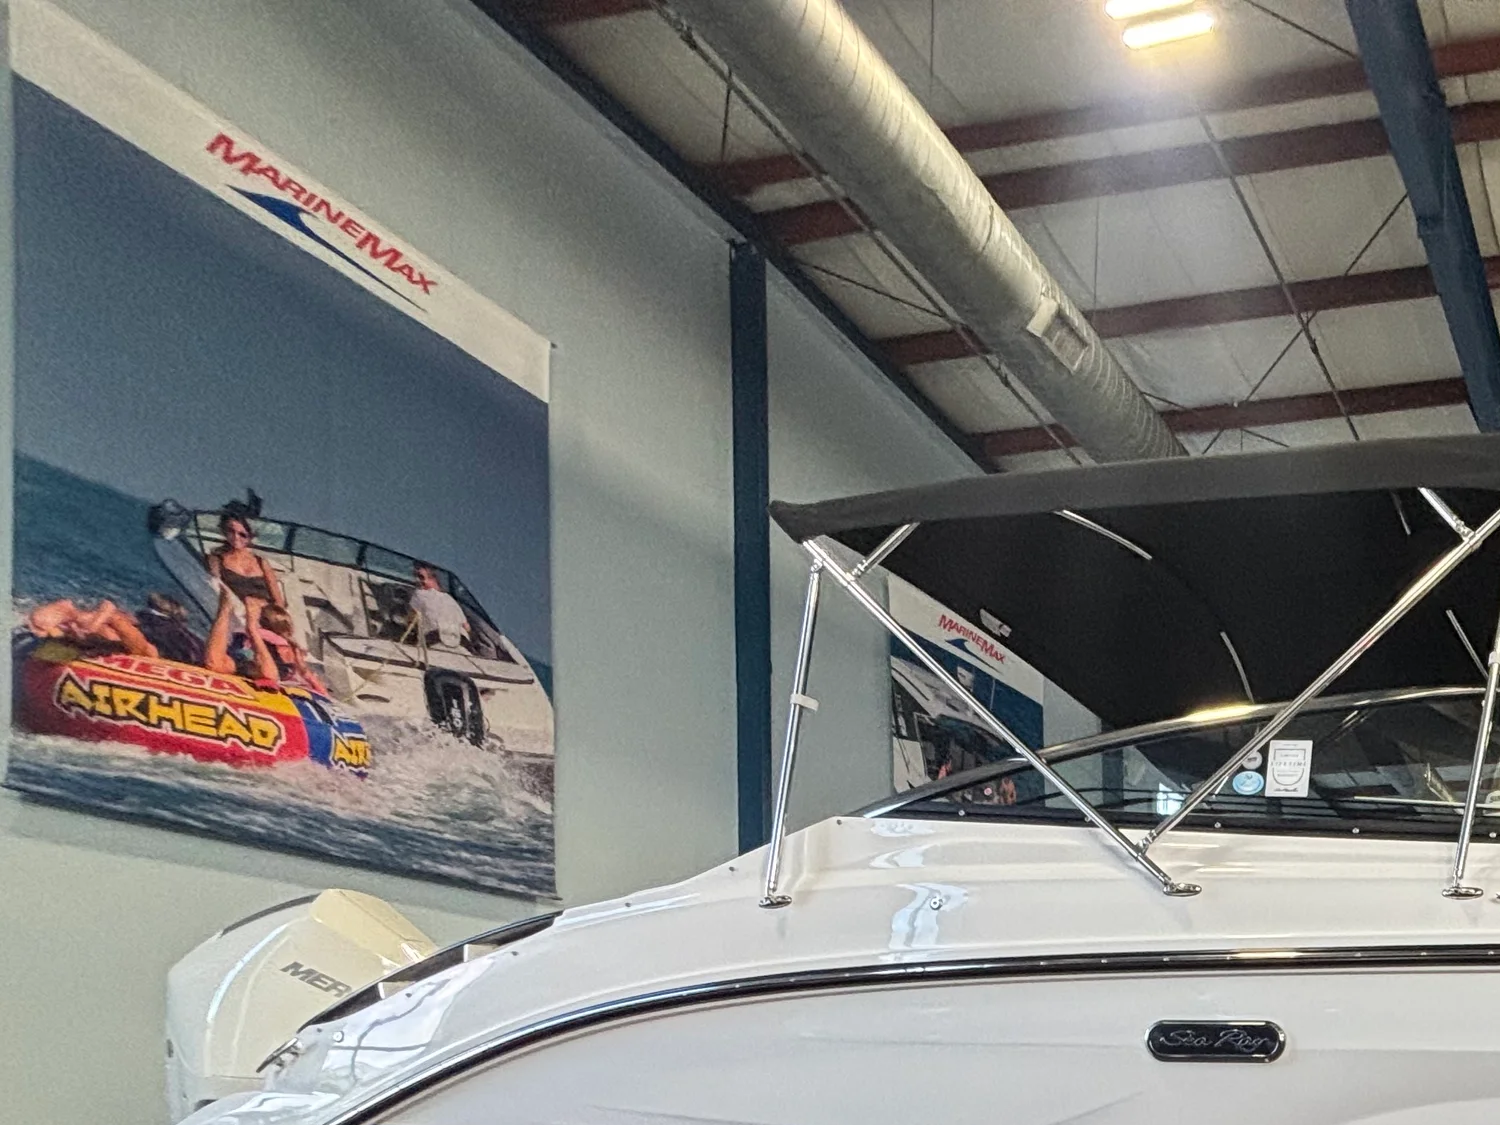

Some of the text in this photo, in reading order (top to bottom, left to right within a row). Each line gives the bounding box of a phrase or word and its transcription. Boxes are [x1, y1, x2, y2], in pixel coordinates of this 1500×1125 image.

[101, 654, 247, 696] MEGA
[58, 676, 283, 753] AIRHEAD
[1160, 1029, 1269, 1053] Sea Ray
